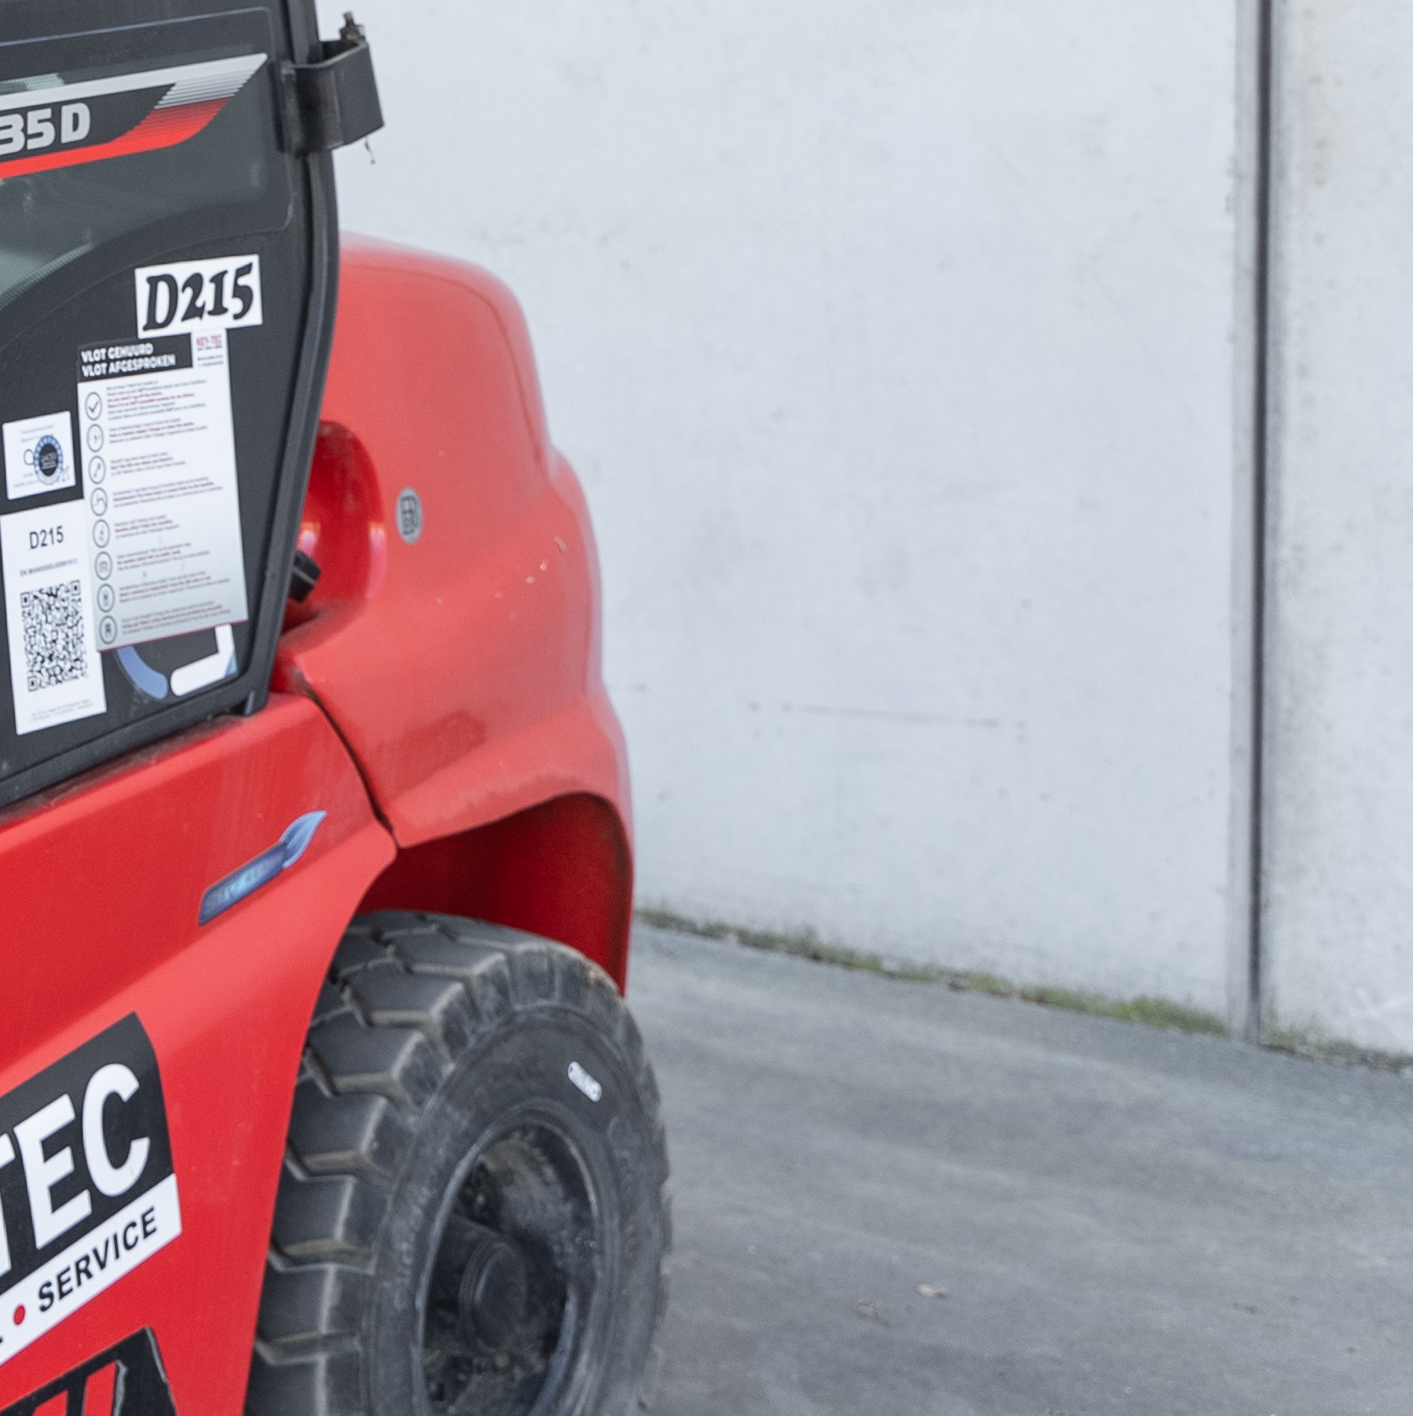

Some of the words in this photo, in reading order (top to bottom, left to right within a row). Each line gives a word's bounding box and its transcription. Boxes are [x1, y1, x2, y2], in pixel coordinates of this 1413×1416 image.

[141, 262, 255, 332] D215
[80, 348, 108, 364] VLOT
[107, 342, 155, 360] GEHUURD
[81, 362, 108, 378] VLOT
[108, 354, 177, 374] AFGESPROKEN
[28, 525, 65, 550] D215
[36, 1206, 160, 1314] SERVICE
